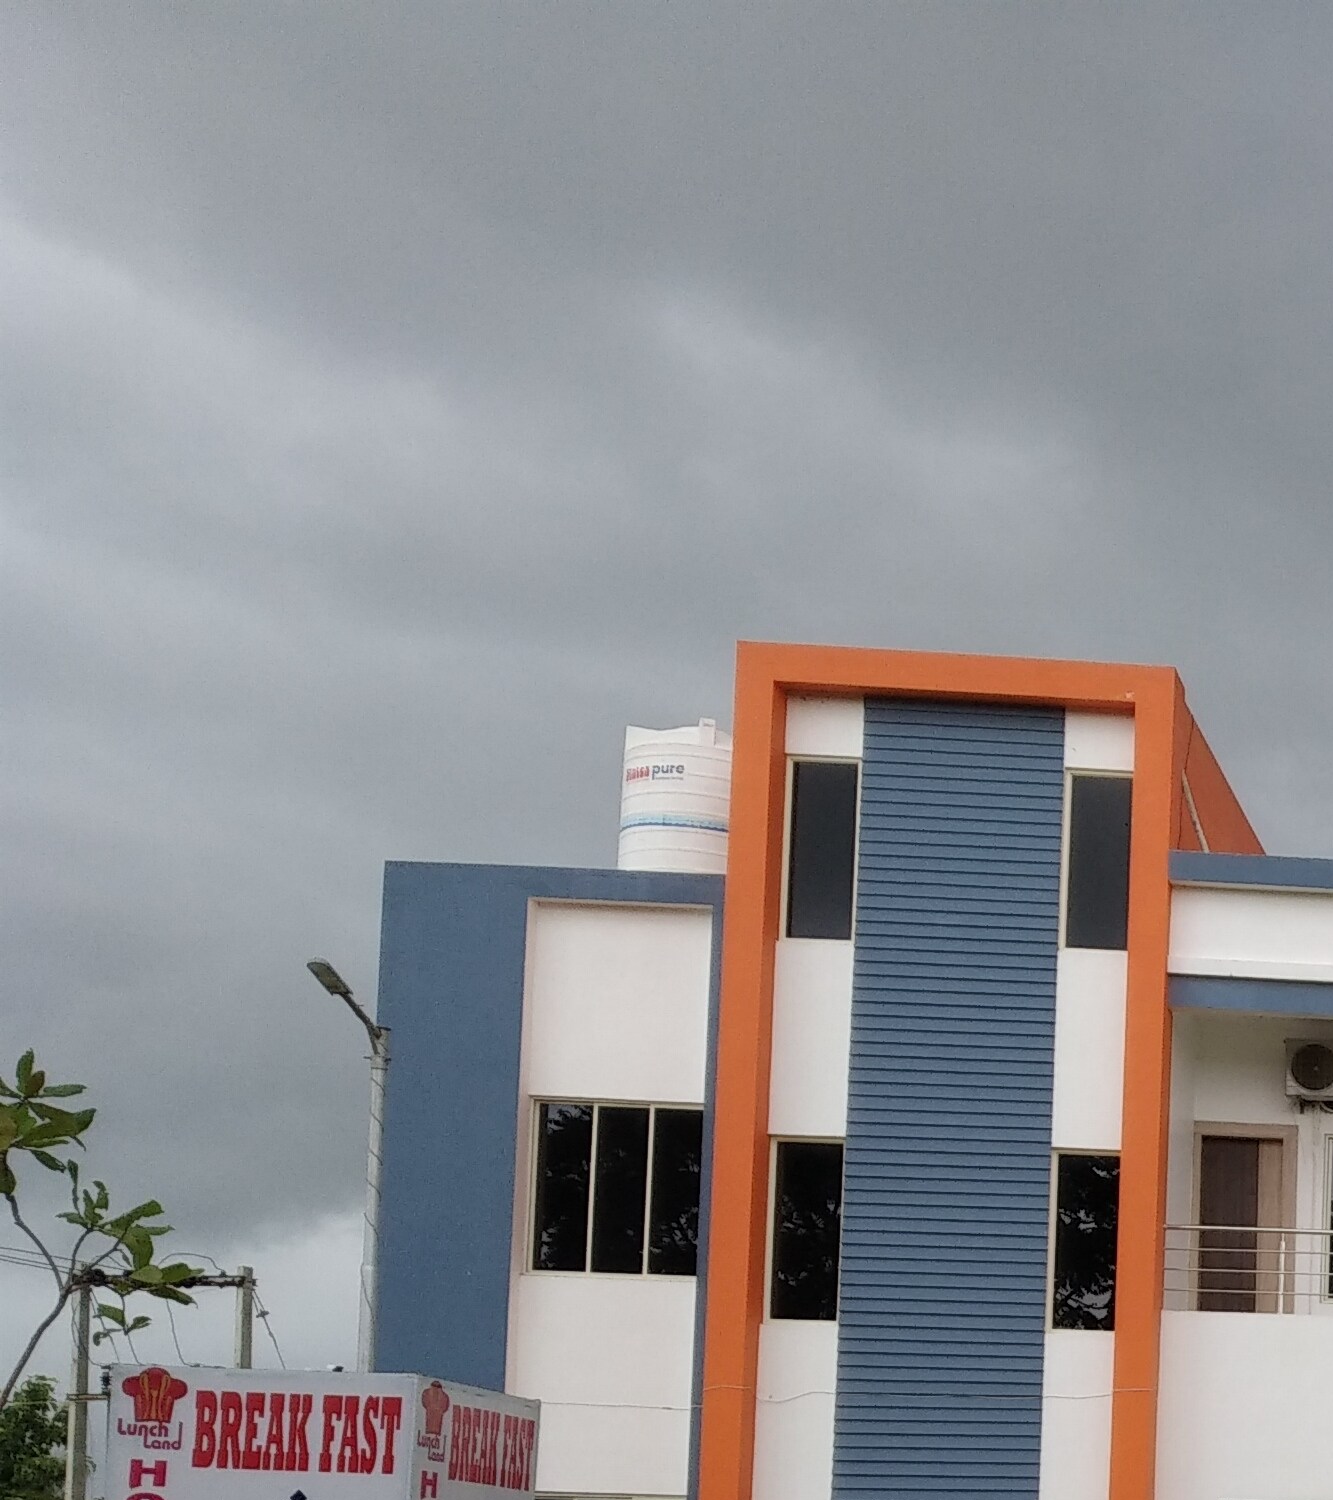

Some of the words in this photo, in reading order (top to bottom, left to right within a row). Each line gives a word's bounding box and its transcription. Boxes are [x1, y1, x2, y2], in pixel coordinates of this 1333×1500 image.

[651, 764, 685, 780] pure
[117, 1418, 169, 1437] Lunch
[143, 1421, 183, 1450] Land
[192, 1390, 314, 1472] BREAK
[319, 1395, 403, 1475] FAST
[448, 1405, 501, 1486] BREAK
[500, 1414, 535, 1491] FAST
